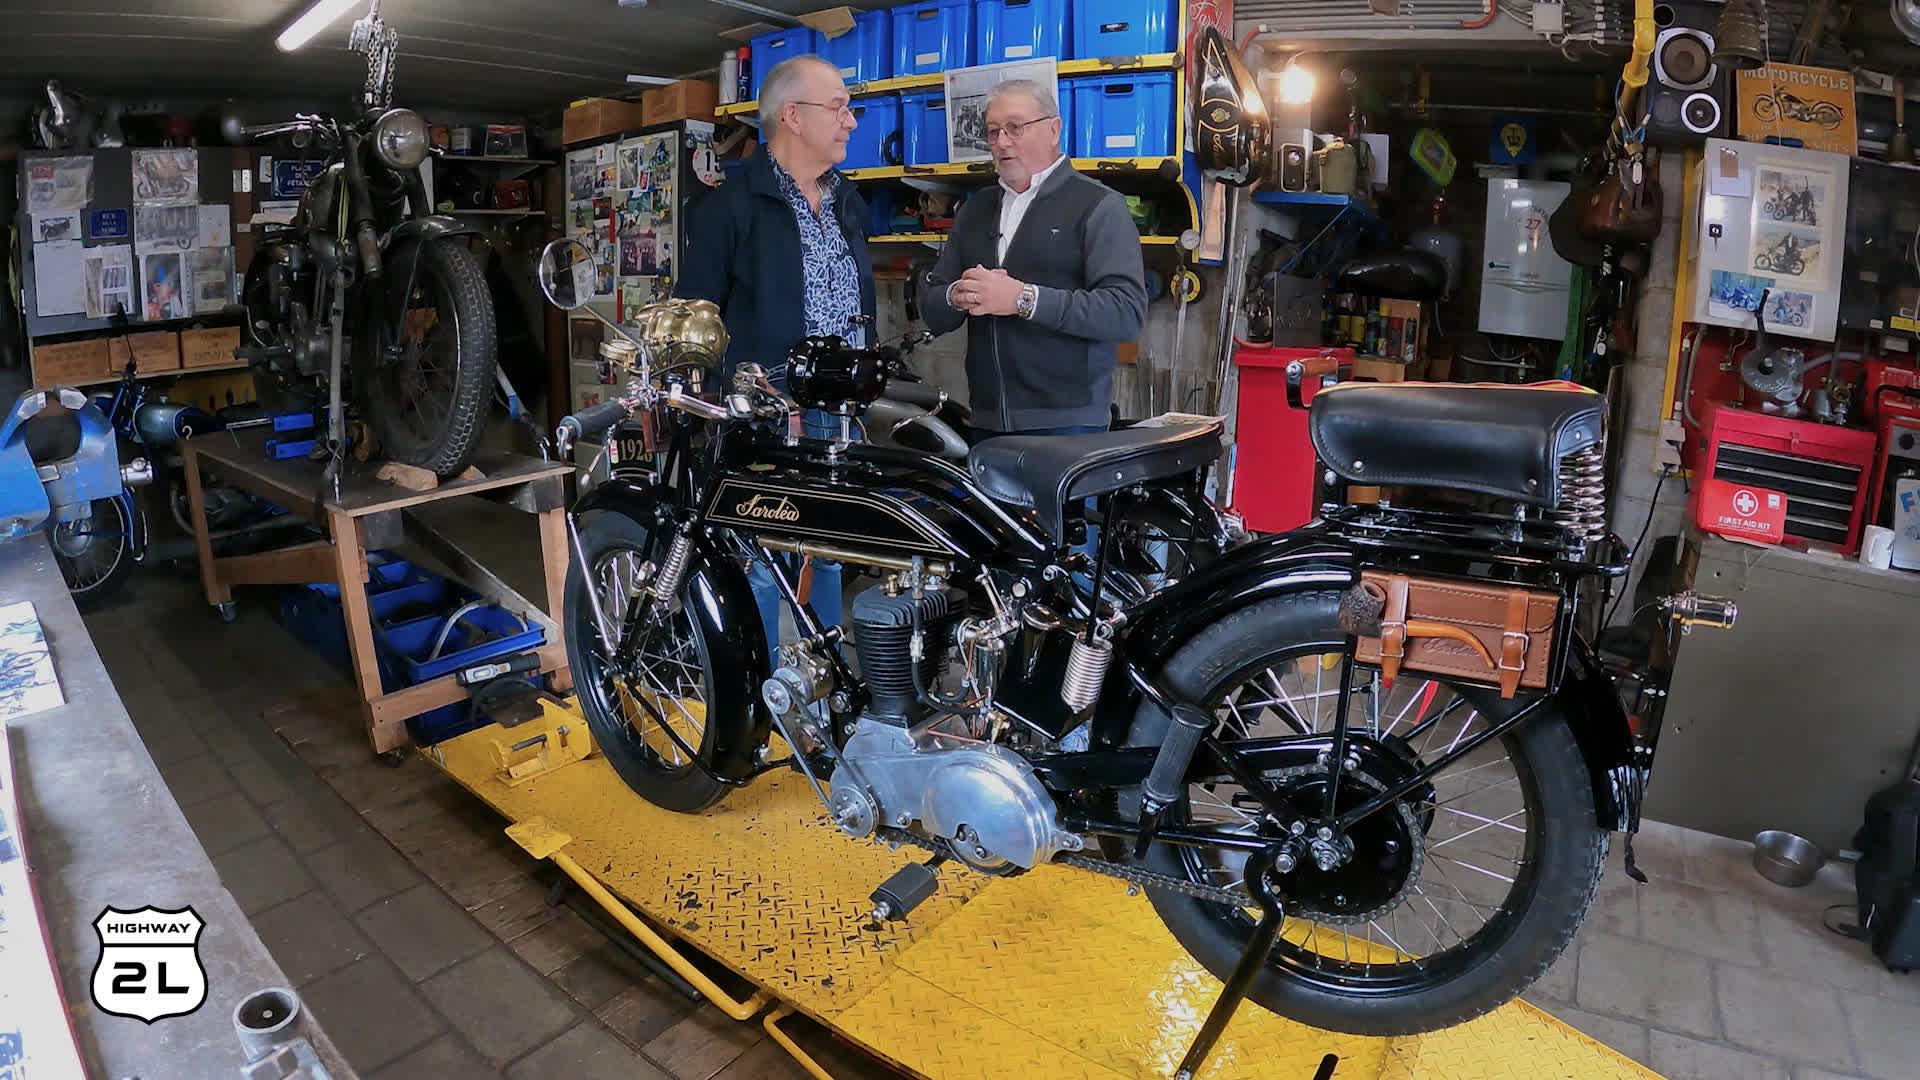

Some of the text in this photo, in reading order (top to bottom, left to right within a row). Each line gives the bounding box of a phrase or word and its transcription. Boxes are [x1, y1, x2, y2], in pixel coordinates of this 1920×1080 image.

[1744, 67, 1848, 90] MOTORCYCLE
[1525, 218, 1541, 230] 27
[1718, 515, 1743, 526] FIRST
[1743, 520, 1757, 528] AID
[1757, 522, 1771, 531] KIT
